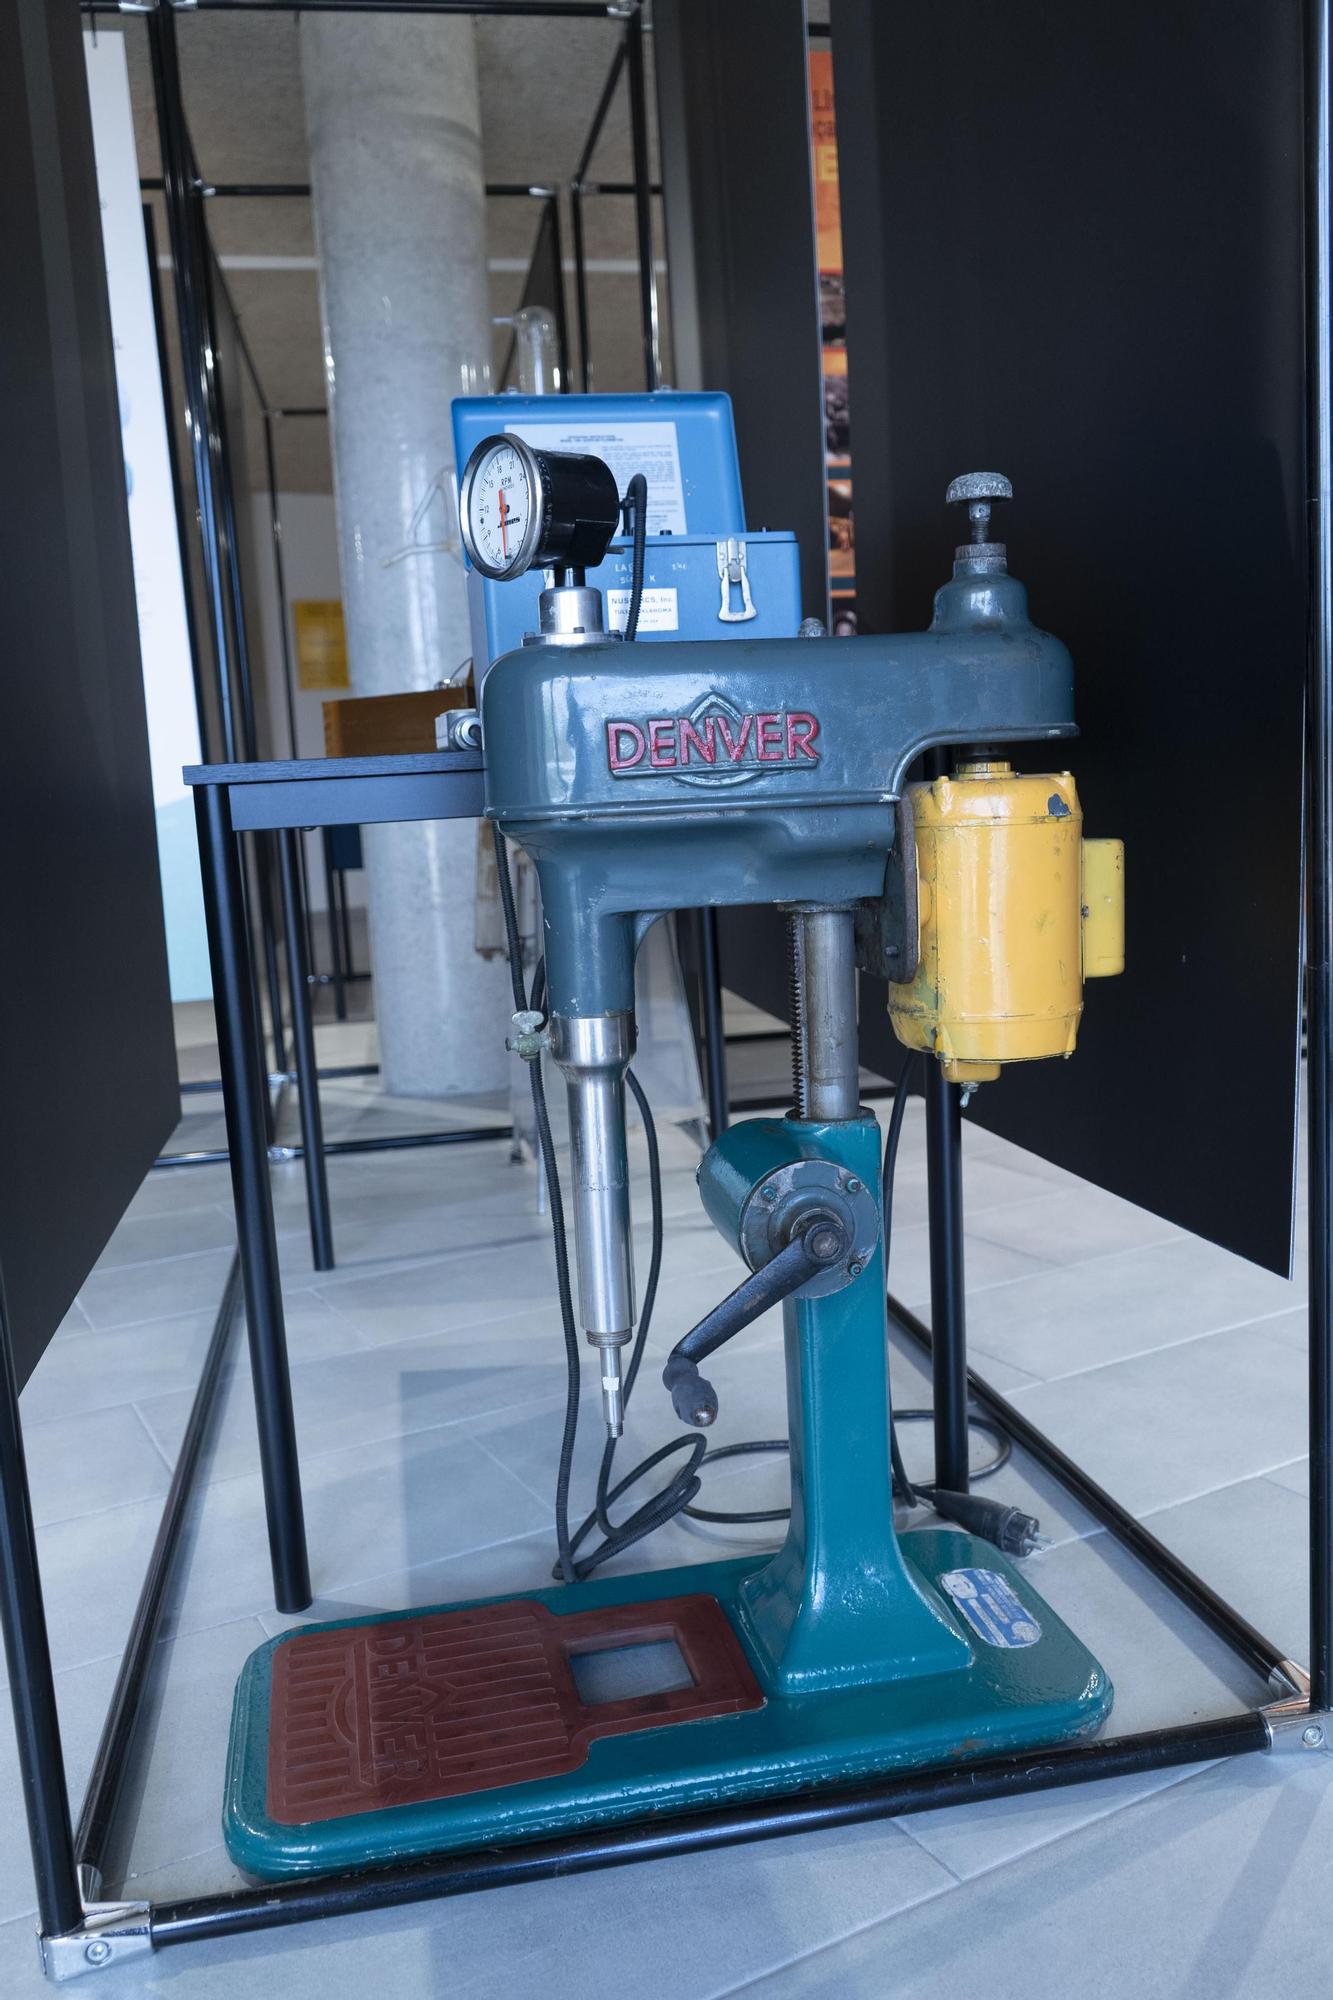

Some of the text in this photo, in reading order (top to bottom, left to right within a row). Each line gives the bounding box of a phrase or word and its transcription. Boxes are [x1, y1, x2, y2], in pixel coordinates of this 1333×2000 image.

[497, 465, 502, 474] 18
[509, 460, 515, 469] 21
[488, 480, 494, 488] 15
[501, 476, 513, 486] RPM
[484, 504, 490, 514] 12
[606, 711, 820, 770] DENVER
[367, 1630, 431, 1787] DENVER
